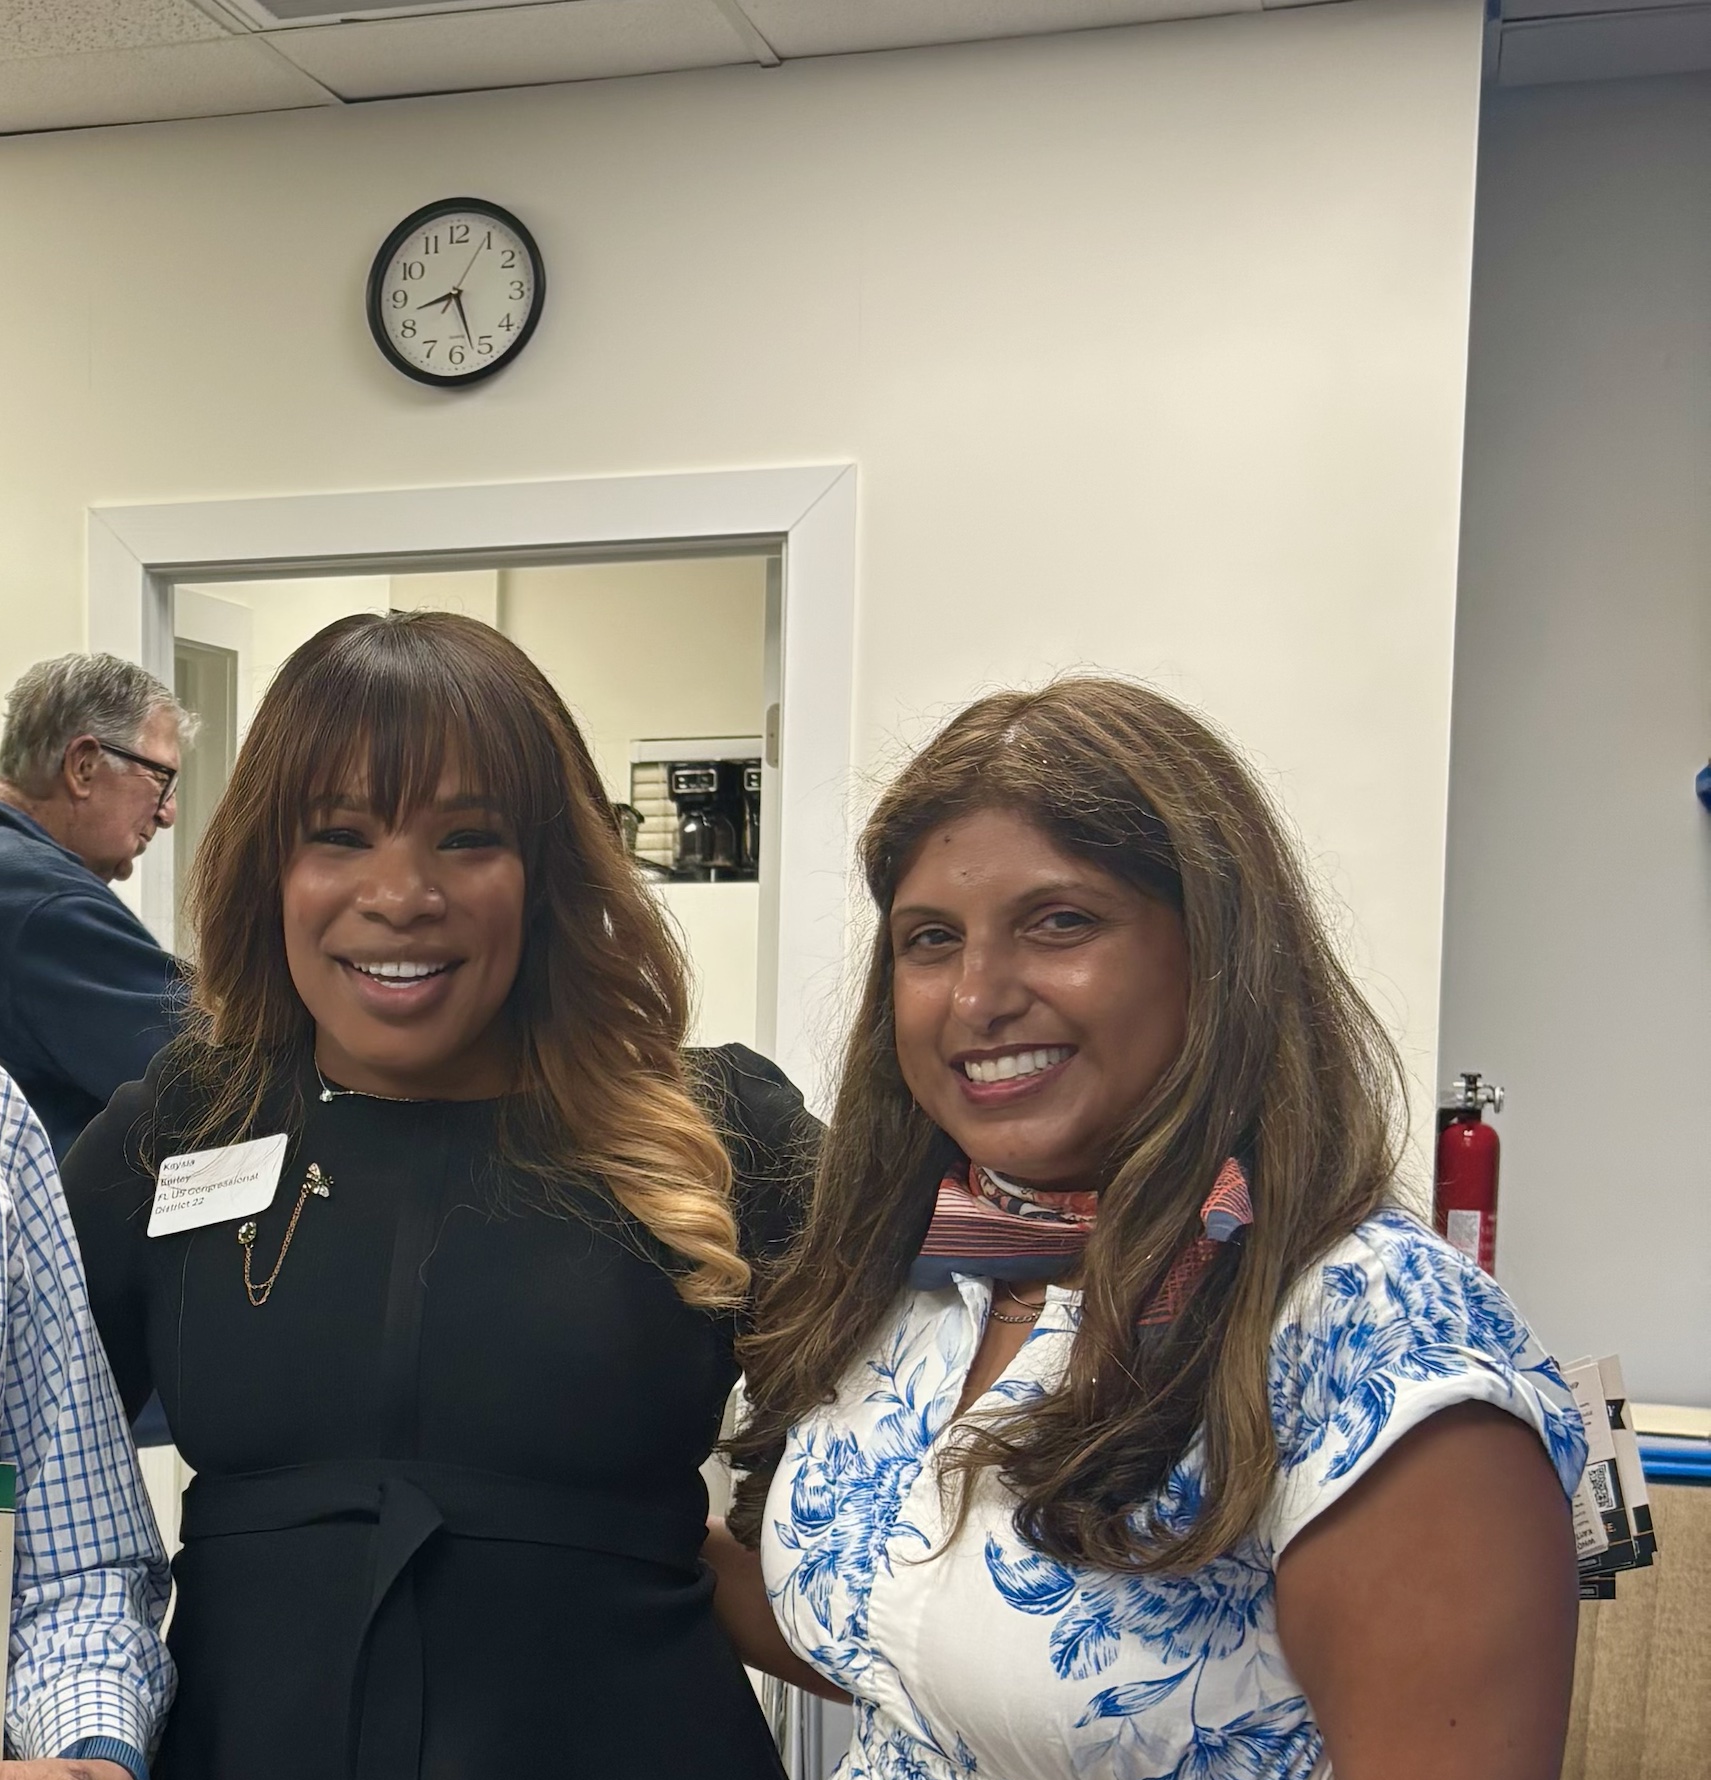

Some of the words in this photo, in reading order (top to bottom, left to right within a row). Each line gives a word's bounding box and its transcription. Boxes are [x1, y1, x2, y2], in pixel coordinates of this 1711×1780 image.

[448, 224, 470, 245] 12
[424, 235, 439, 254] 11
[500, 250, 516, 269] 2
[401, 261, 425, 281] 10
[392, 289, 408, 309] 9
[508, 280, 525, 301] 3
[400, 319, 417, 338] 8
[497, 313, 514, 332] 4
[422, 340, 438, 359] 7
[448, 345, 465, 364] 6
[477, 335, 493, 355] 5
